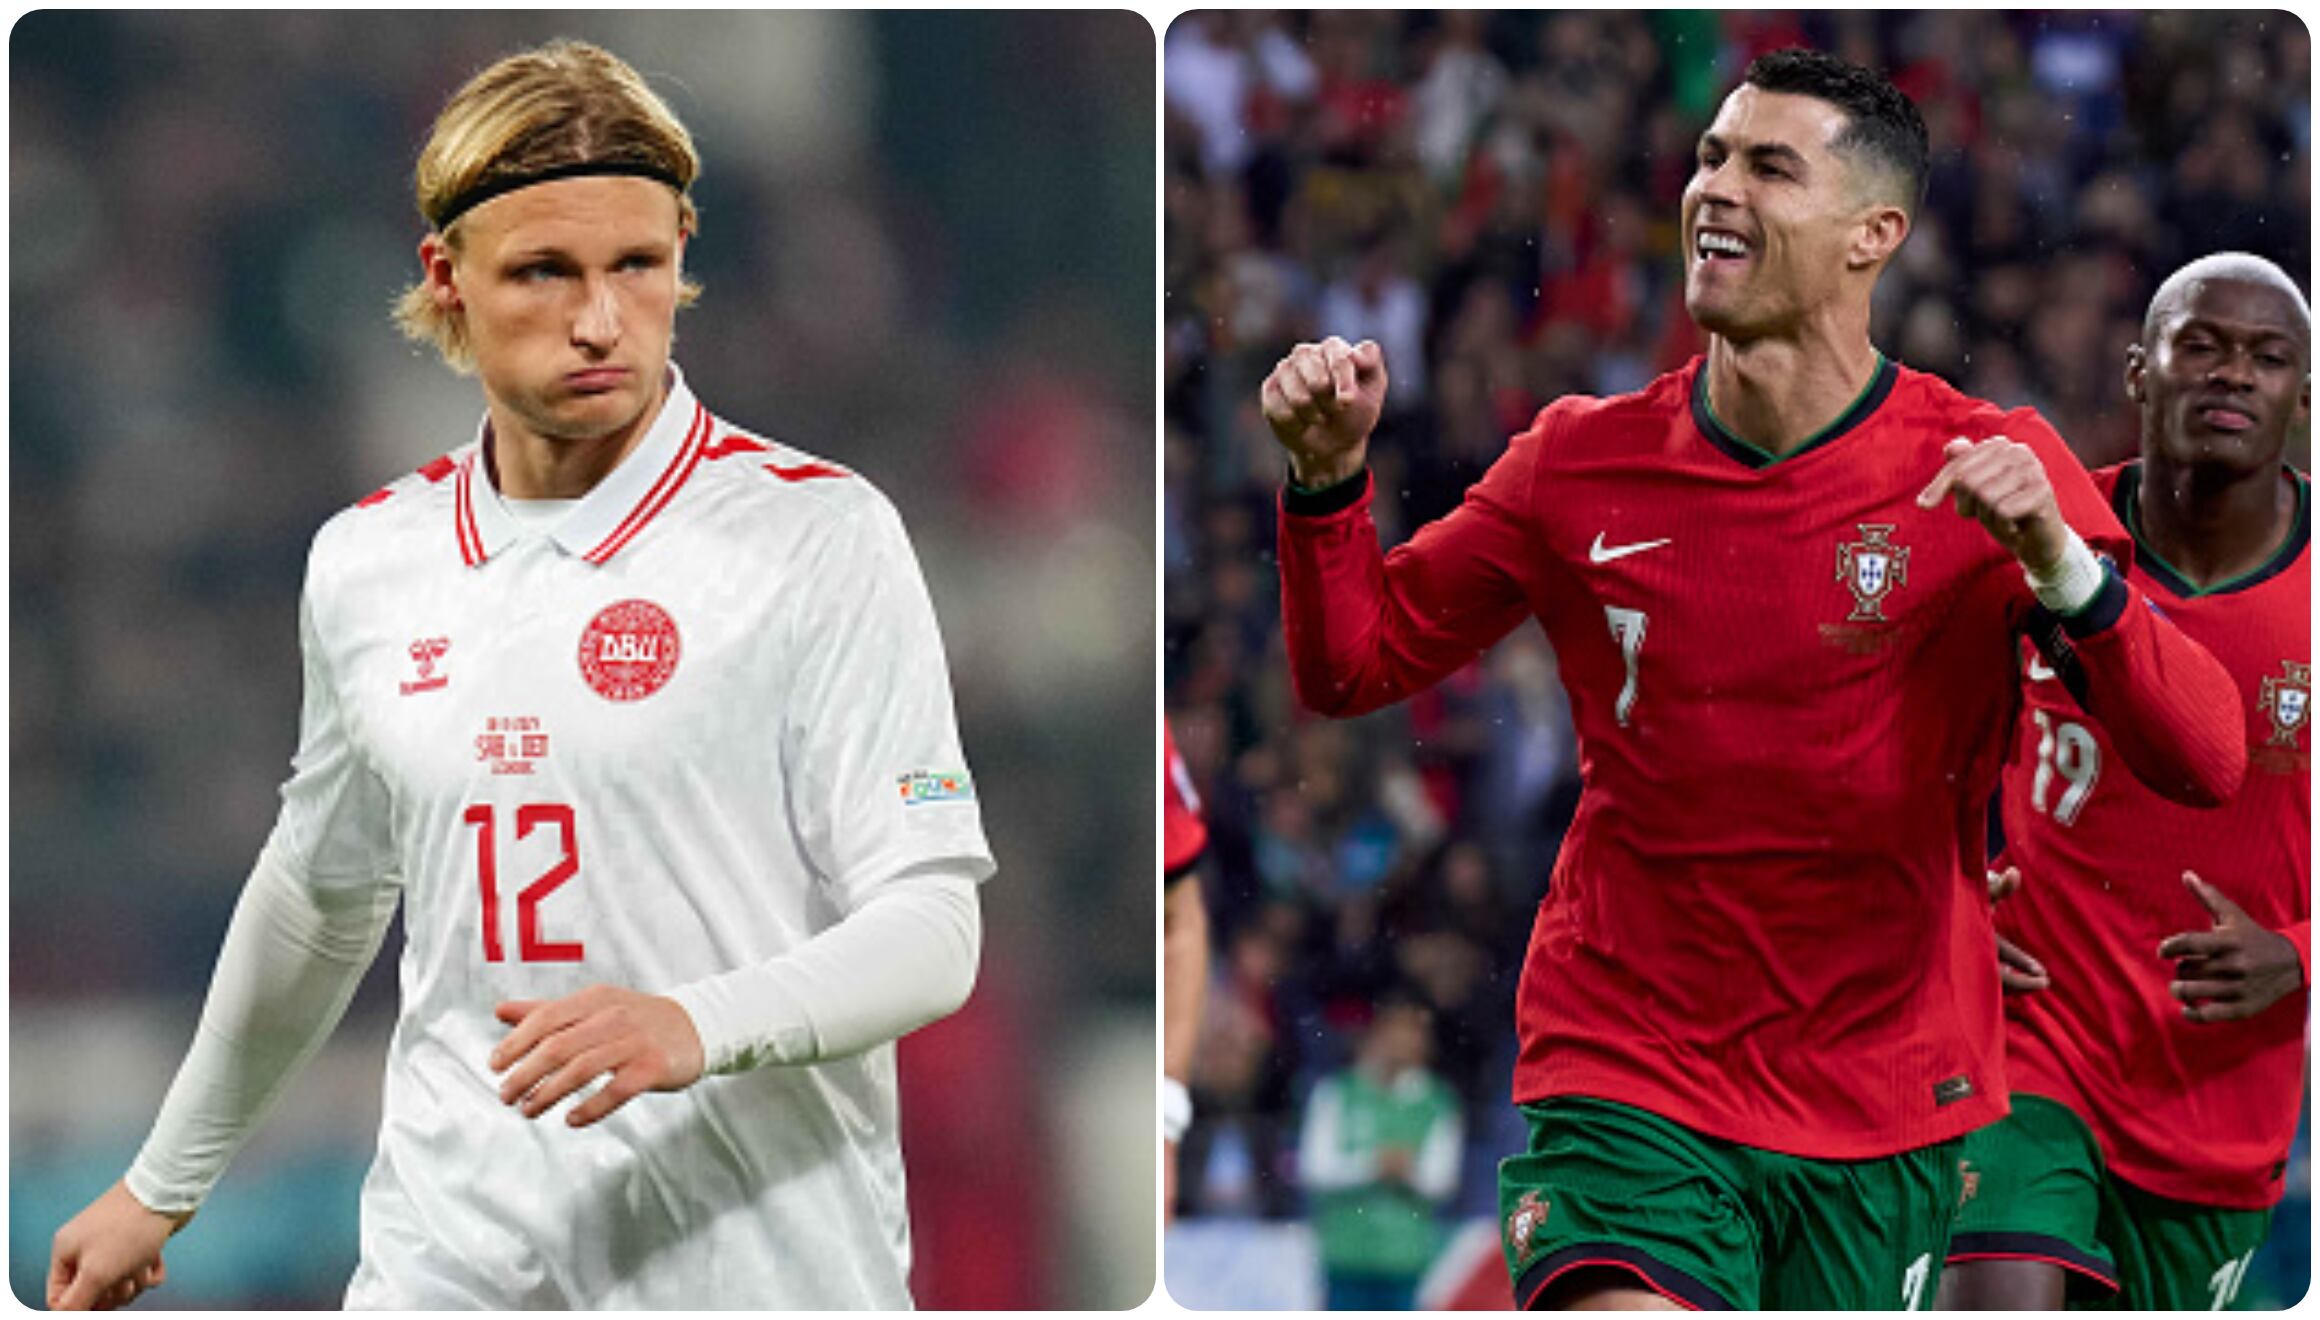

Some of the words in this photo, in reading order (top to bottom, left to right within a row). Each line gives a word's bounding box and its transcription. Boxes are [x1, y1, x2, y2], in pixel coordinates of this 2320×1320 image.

[1604, 604, 1649, 728] 7
[2033, 708, 2099, 828] 19
[463, 804, 585, 963] 12
